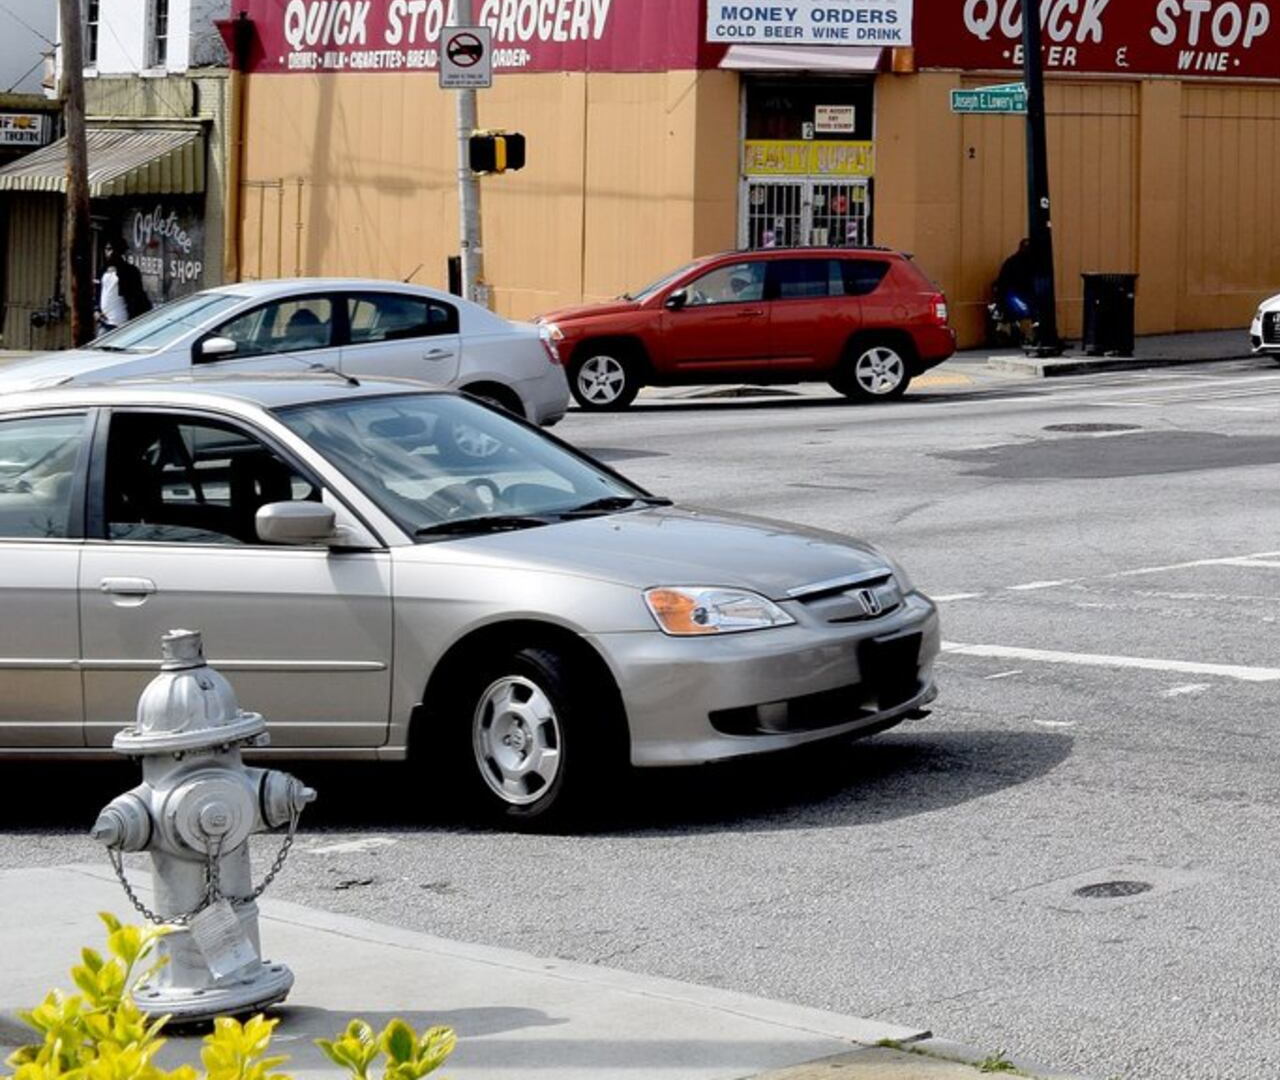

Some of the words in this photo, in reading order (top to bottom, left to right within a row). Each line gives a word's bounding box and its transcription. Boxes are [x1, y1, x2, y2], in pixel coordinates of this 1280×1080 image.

[721, 6, 798, 21] MONEY
[811, 8, 897, 24] ORDERS
[716, 25, 756, 37] COLD
[764, 26, 804, 38] BEER
[812, 27, 849, 39] WINE
[857, 28, 901, 40] DRINK
[350, 50, 401, 68] CIGARETTES
[1012, 44, 1077, 66] BER
[1177, 50, 1229, 71] WINE
[953, 93, 979, 111] Joseph
[987, 93, 1013, 111] Lowery
[133, 204, 192, 253] Ogletree
[170, 260, 202, 284] SHOP
